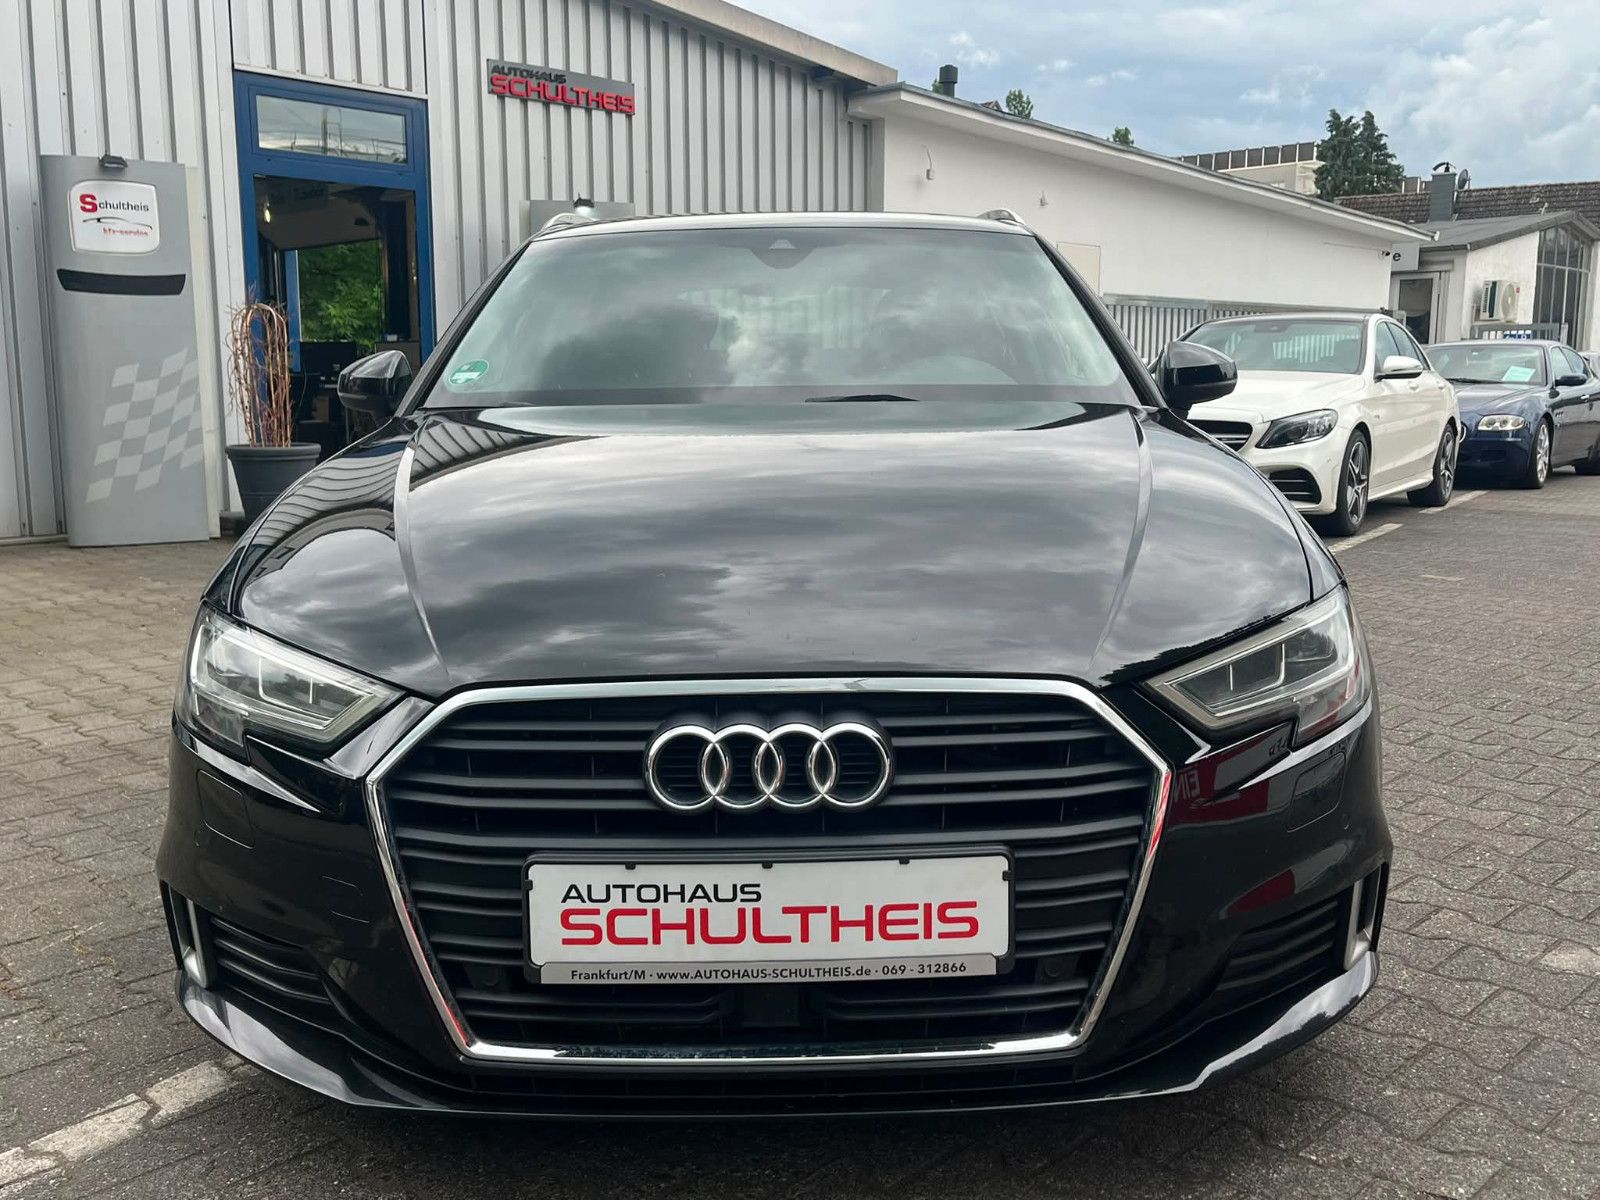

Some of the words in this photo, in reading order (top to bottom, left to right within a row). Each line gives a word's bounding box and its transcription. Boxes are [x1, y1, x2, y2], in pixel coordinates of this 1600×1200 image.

[491, 64, 566, 83] AUTOHAUS
[490, 74, 635, 113] SCHULTHEIS
[79, 193, 149, 213] Schultheis
[561, 883, 762, 904] AUTOHAUS
[560, 901, 979, 946] SCHULTHEIS
[571, 969, 646, 981] Frankfurt/M
[657, 966, 871, 980] www.AUTOHAUS-SCHULTHEIS.de
[882, 964, 906, 976] 069
[918, 962, 967, 975] 312866
